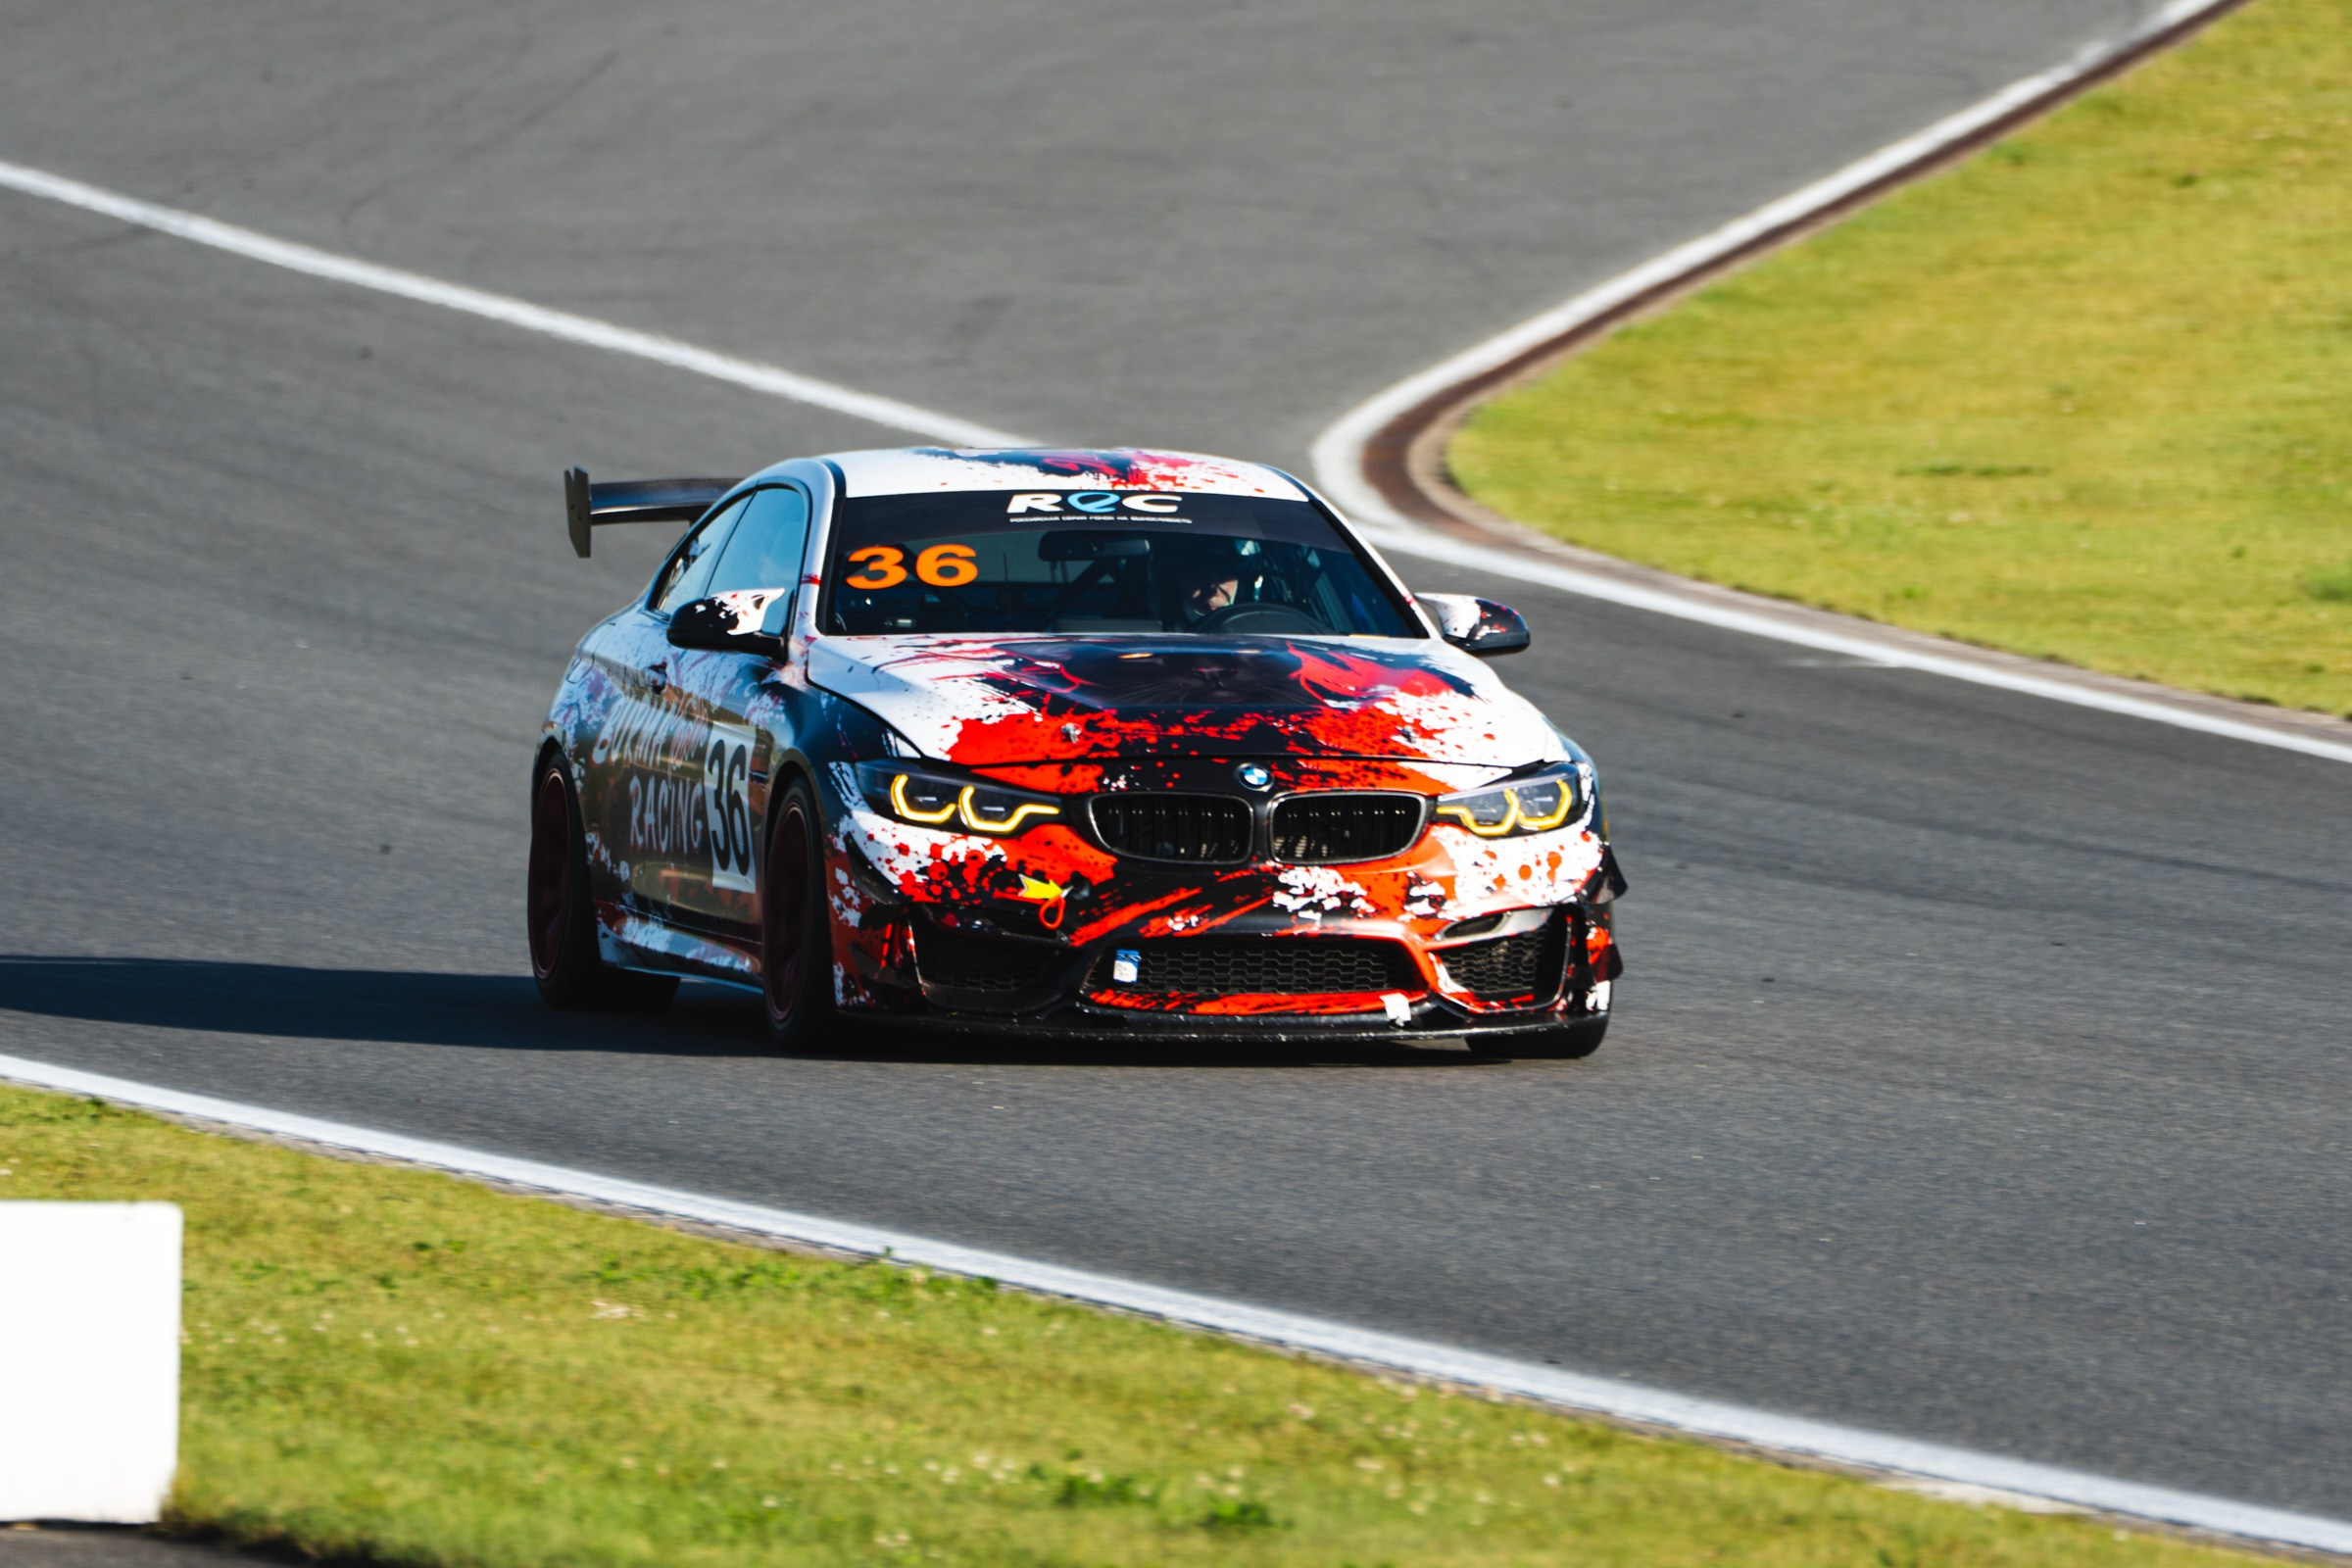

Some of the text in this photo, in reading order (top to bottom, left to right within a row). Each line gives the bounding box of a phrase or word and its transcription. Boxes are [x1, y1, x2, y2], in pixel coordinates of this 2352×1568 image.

[846, 543, 979, 590] 36
[629, 774, 704, 855] RACING
[708, 738, 750, 876] 36
